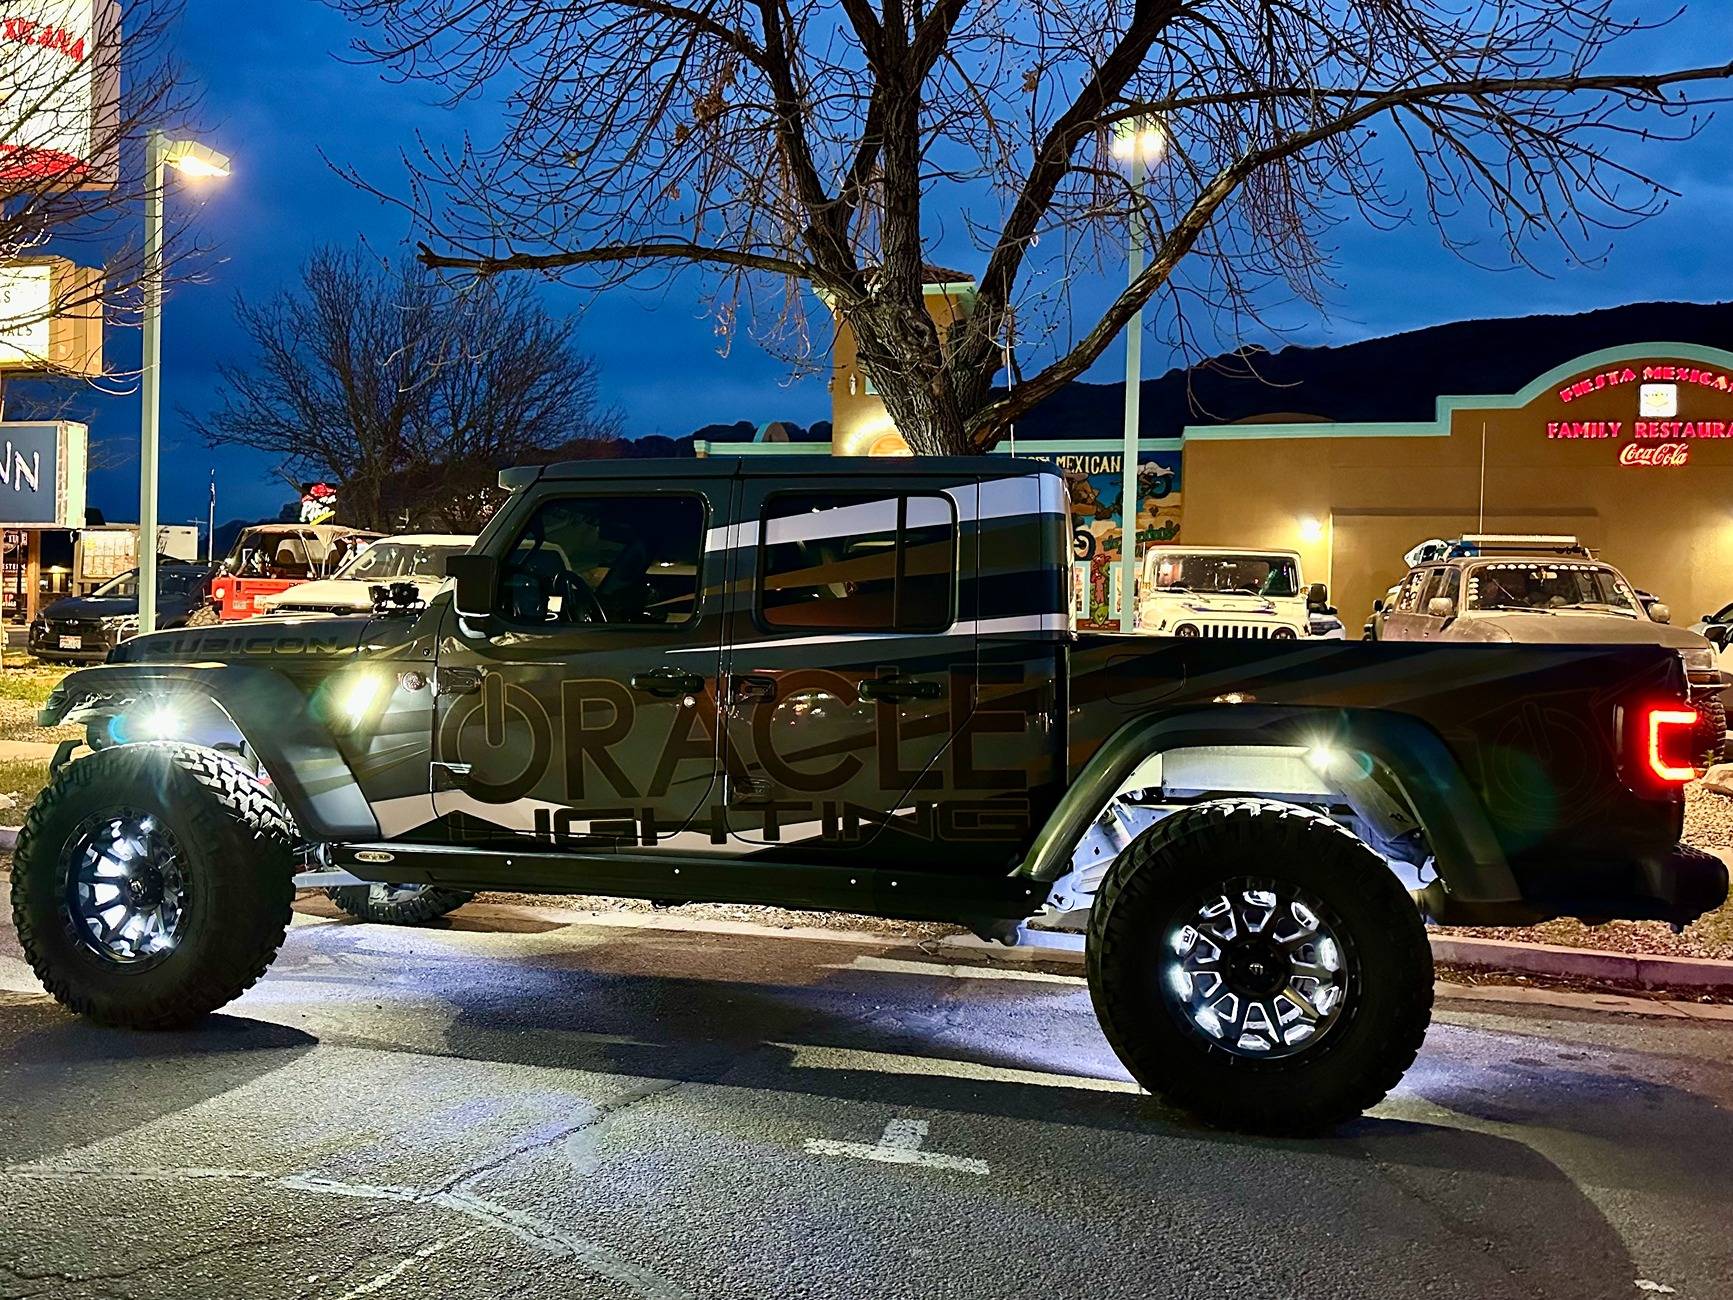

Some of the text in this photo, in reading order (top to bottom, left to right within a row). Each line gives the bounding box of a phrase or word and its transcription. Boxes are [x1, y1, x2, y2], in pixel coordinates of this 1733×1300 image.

[1559, 368, 1637, 403] FIESTA
[1547, 422, 1622, 439] FAMILY
[1055, 455, 1122, 475] MEXICAN
[145, 636, 339, 655] RUBICON
[439, 663, 1028, 805] ORACLE
[446, 799, 1031, 847] LIGHTING
